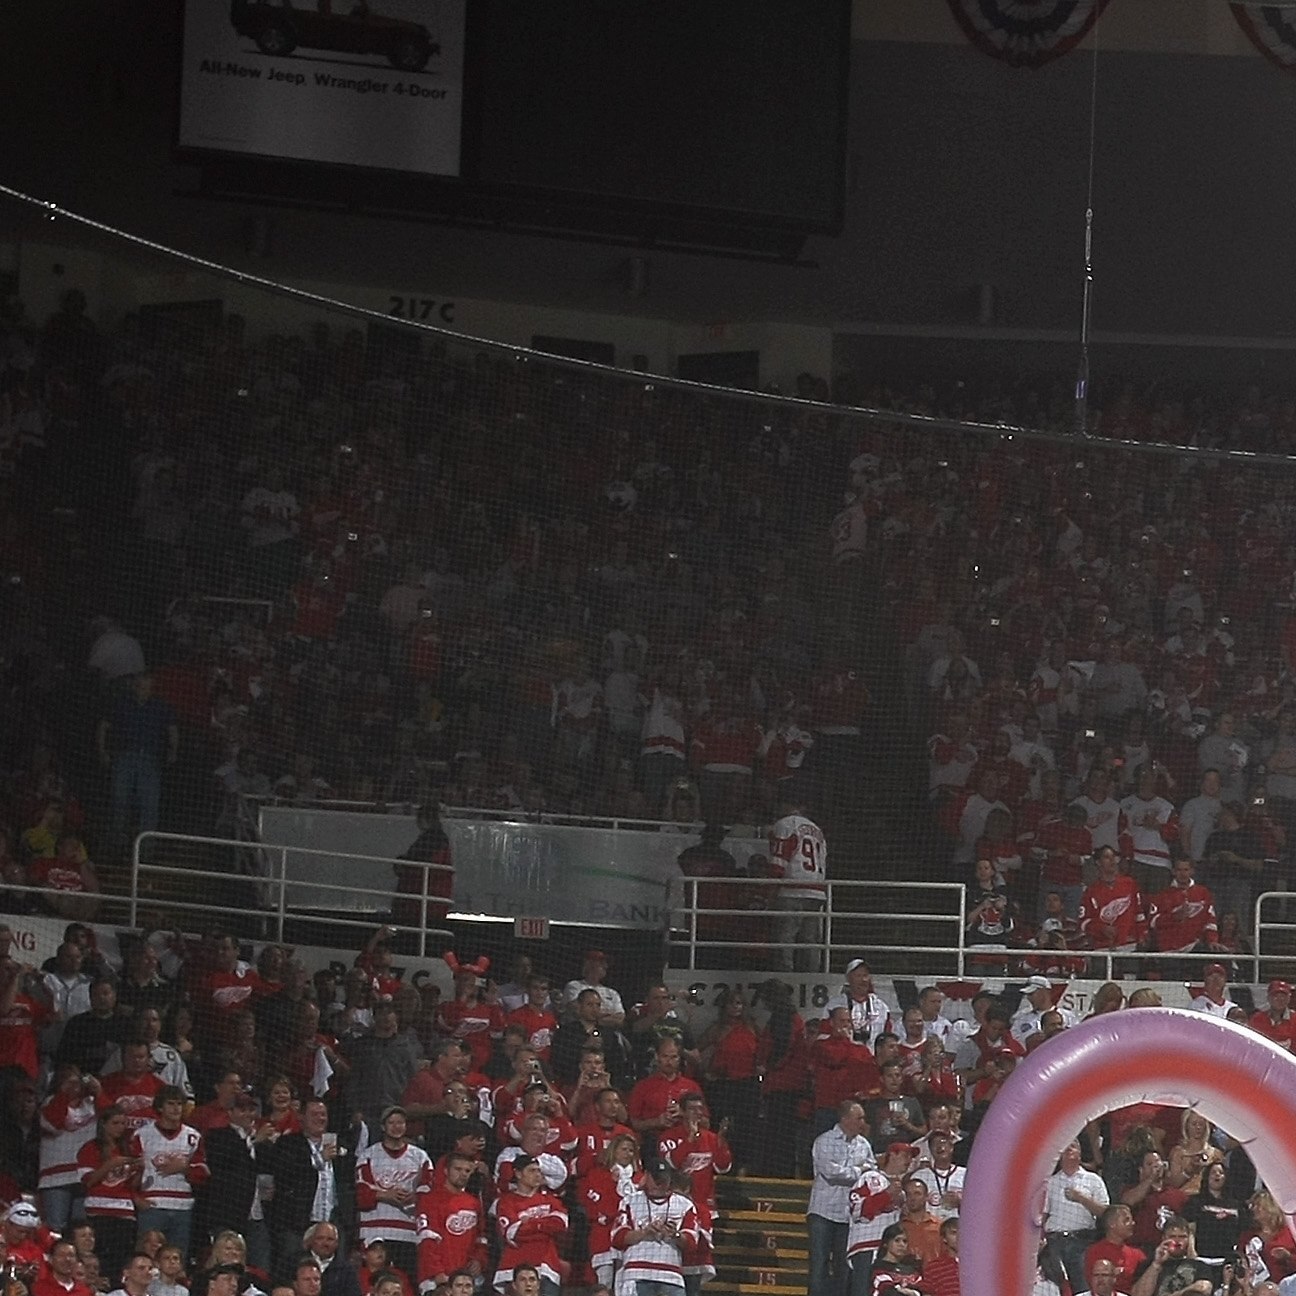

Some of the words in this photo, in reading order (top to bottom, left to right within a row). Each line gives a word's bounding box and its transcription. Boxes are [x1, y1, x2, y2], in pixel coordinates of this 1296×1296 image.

[199, 59, 261, 79] All-New
[313, 73, 388, 94] Wrangler
[392, 82, 448, 100] 4-Door
